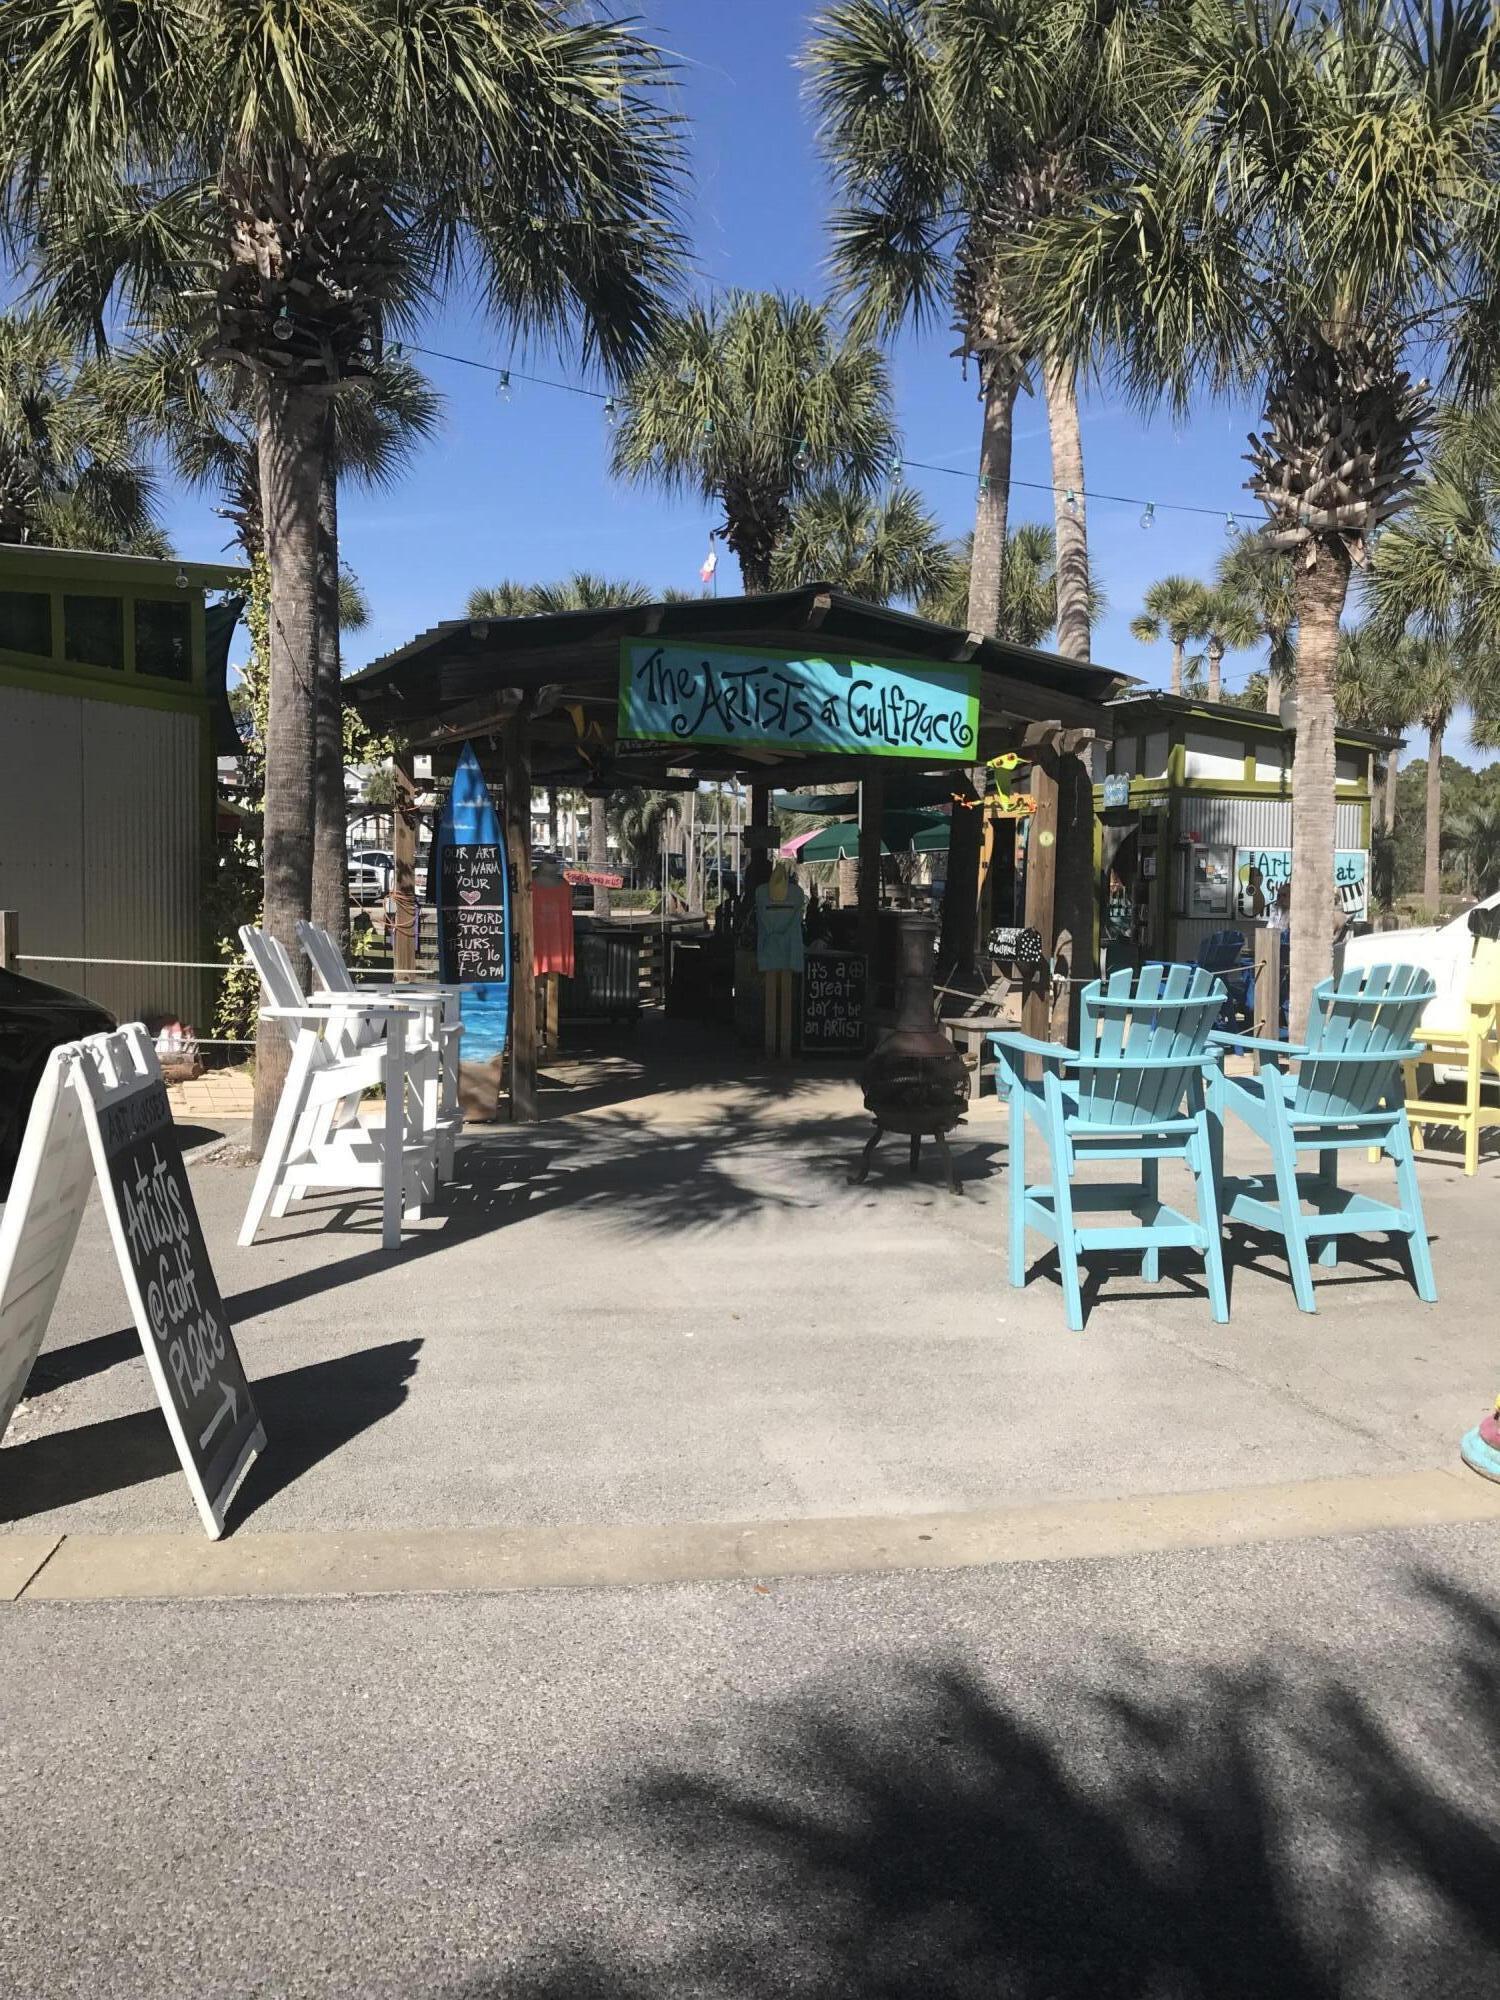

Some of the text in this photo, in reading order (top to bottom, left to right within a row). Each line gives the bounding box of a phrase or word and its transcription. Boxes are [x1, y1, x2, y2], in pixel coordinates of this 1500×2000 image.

[636, 648, 696, 706] The
[445, 845, 498, 860] OUR ART
[471, 861, 502, 877] WARM
[1336, 859, 1356, 880] at
[456, 876, 492, 890] YOUR
[457, 923, 505, 937] STROLL
[458, 948, 501, 963] FEB. 16
[489, 963, 505, 978] PM
[807, 959, 846, 980] It's a
[809, 979, 857, 999] great
[832, 1001, 845, 1017] to
[848, 1001, 862, 1017] be
[804, 1017, 864, 1039] an ARTIST
[123, 1141, 190, 1266] Artists
